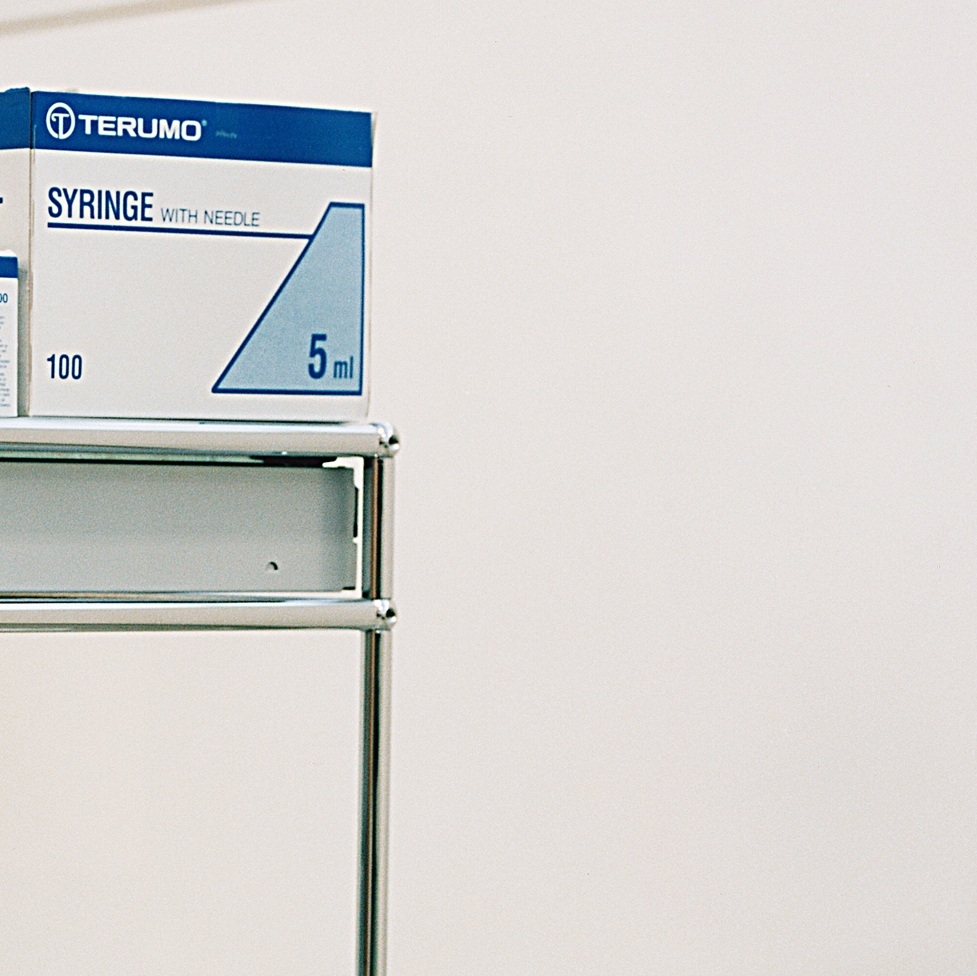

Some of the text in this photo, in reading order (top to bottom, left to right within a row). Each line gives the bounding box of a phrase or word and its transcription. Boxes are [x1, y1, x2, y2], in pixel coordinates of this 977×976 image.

[78, 114, 202, 141] TERUMO
[48, 187, 260, 227] SYRINGE WITH NEEDLE
[46, 354, 82, 380] 100
[308, 333, 354, 379] 5 ml
